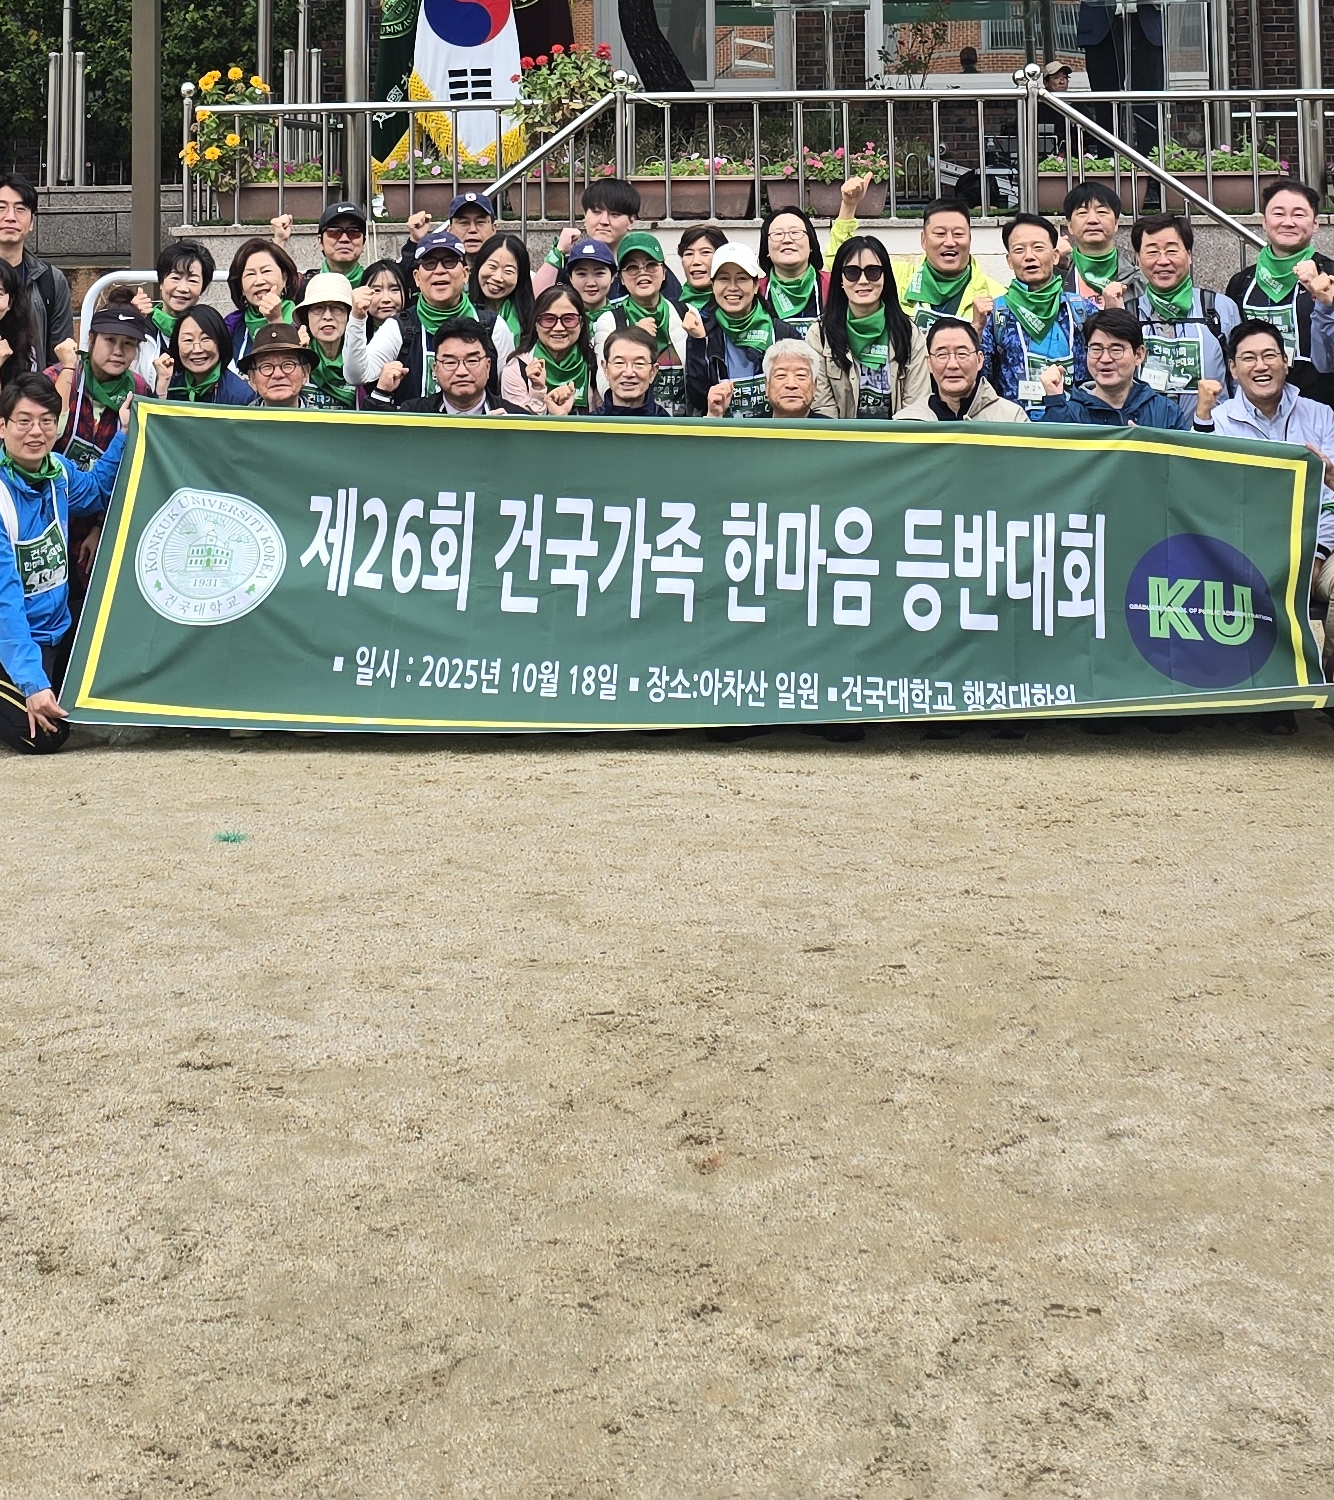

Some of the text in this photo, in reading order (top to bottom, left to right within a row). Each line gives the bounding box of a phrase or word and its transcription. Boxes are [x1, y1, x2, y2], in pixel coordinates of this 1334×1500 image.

[144, 495, 276, 580] KONKUK UNIVERSITY KOREA
[299, 487, 1106, 640] 제26회 건국가족 한마음 등반대회
[164, 594, 241, 617] 건국대학교
[192, 578, 218, 588] 1931
[1148, 576, 1255, 646] KU
[355, 646, 400, 689] 일시
[418, 655, 502, 695] 2025년
[511, 660, 560, 698] 10월
[569, 663, 618, 701] 18일
[646, 665, 769, 708] 장소:아차산
[775, 671, 819, 710] 일원
[841, 675, 957, 714] 건국대학교
